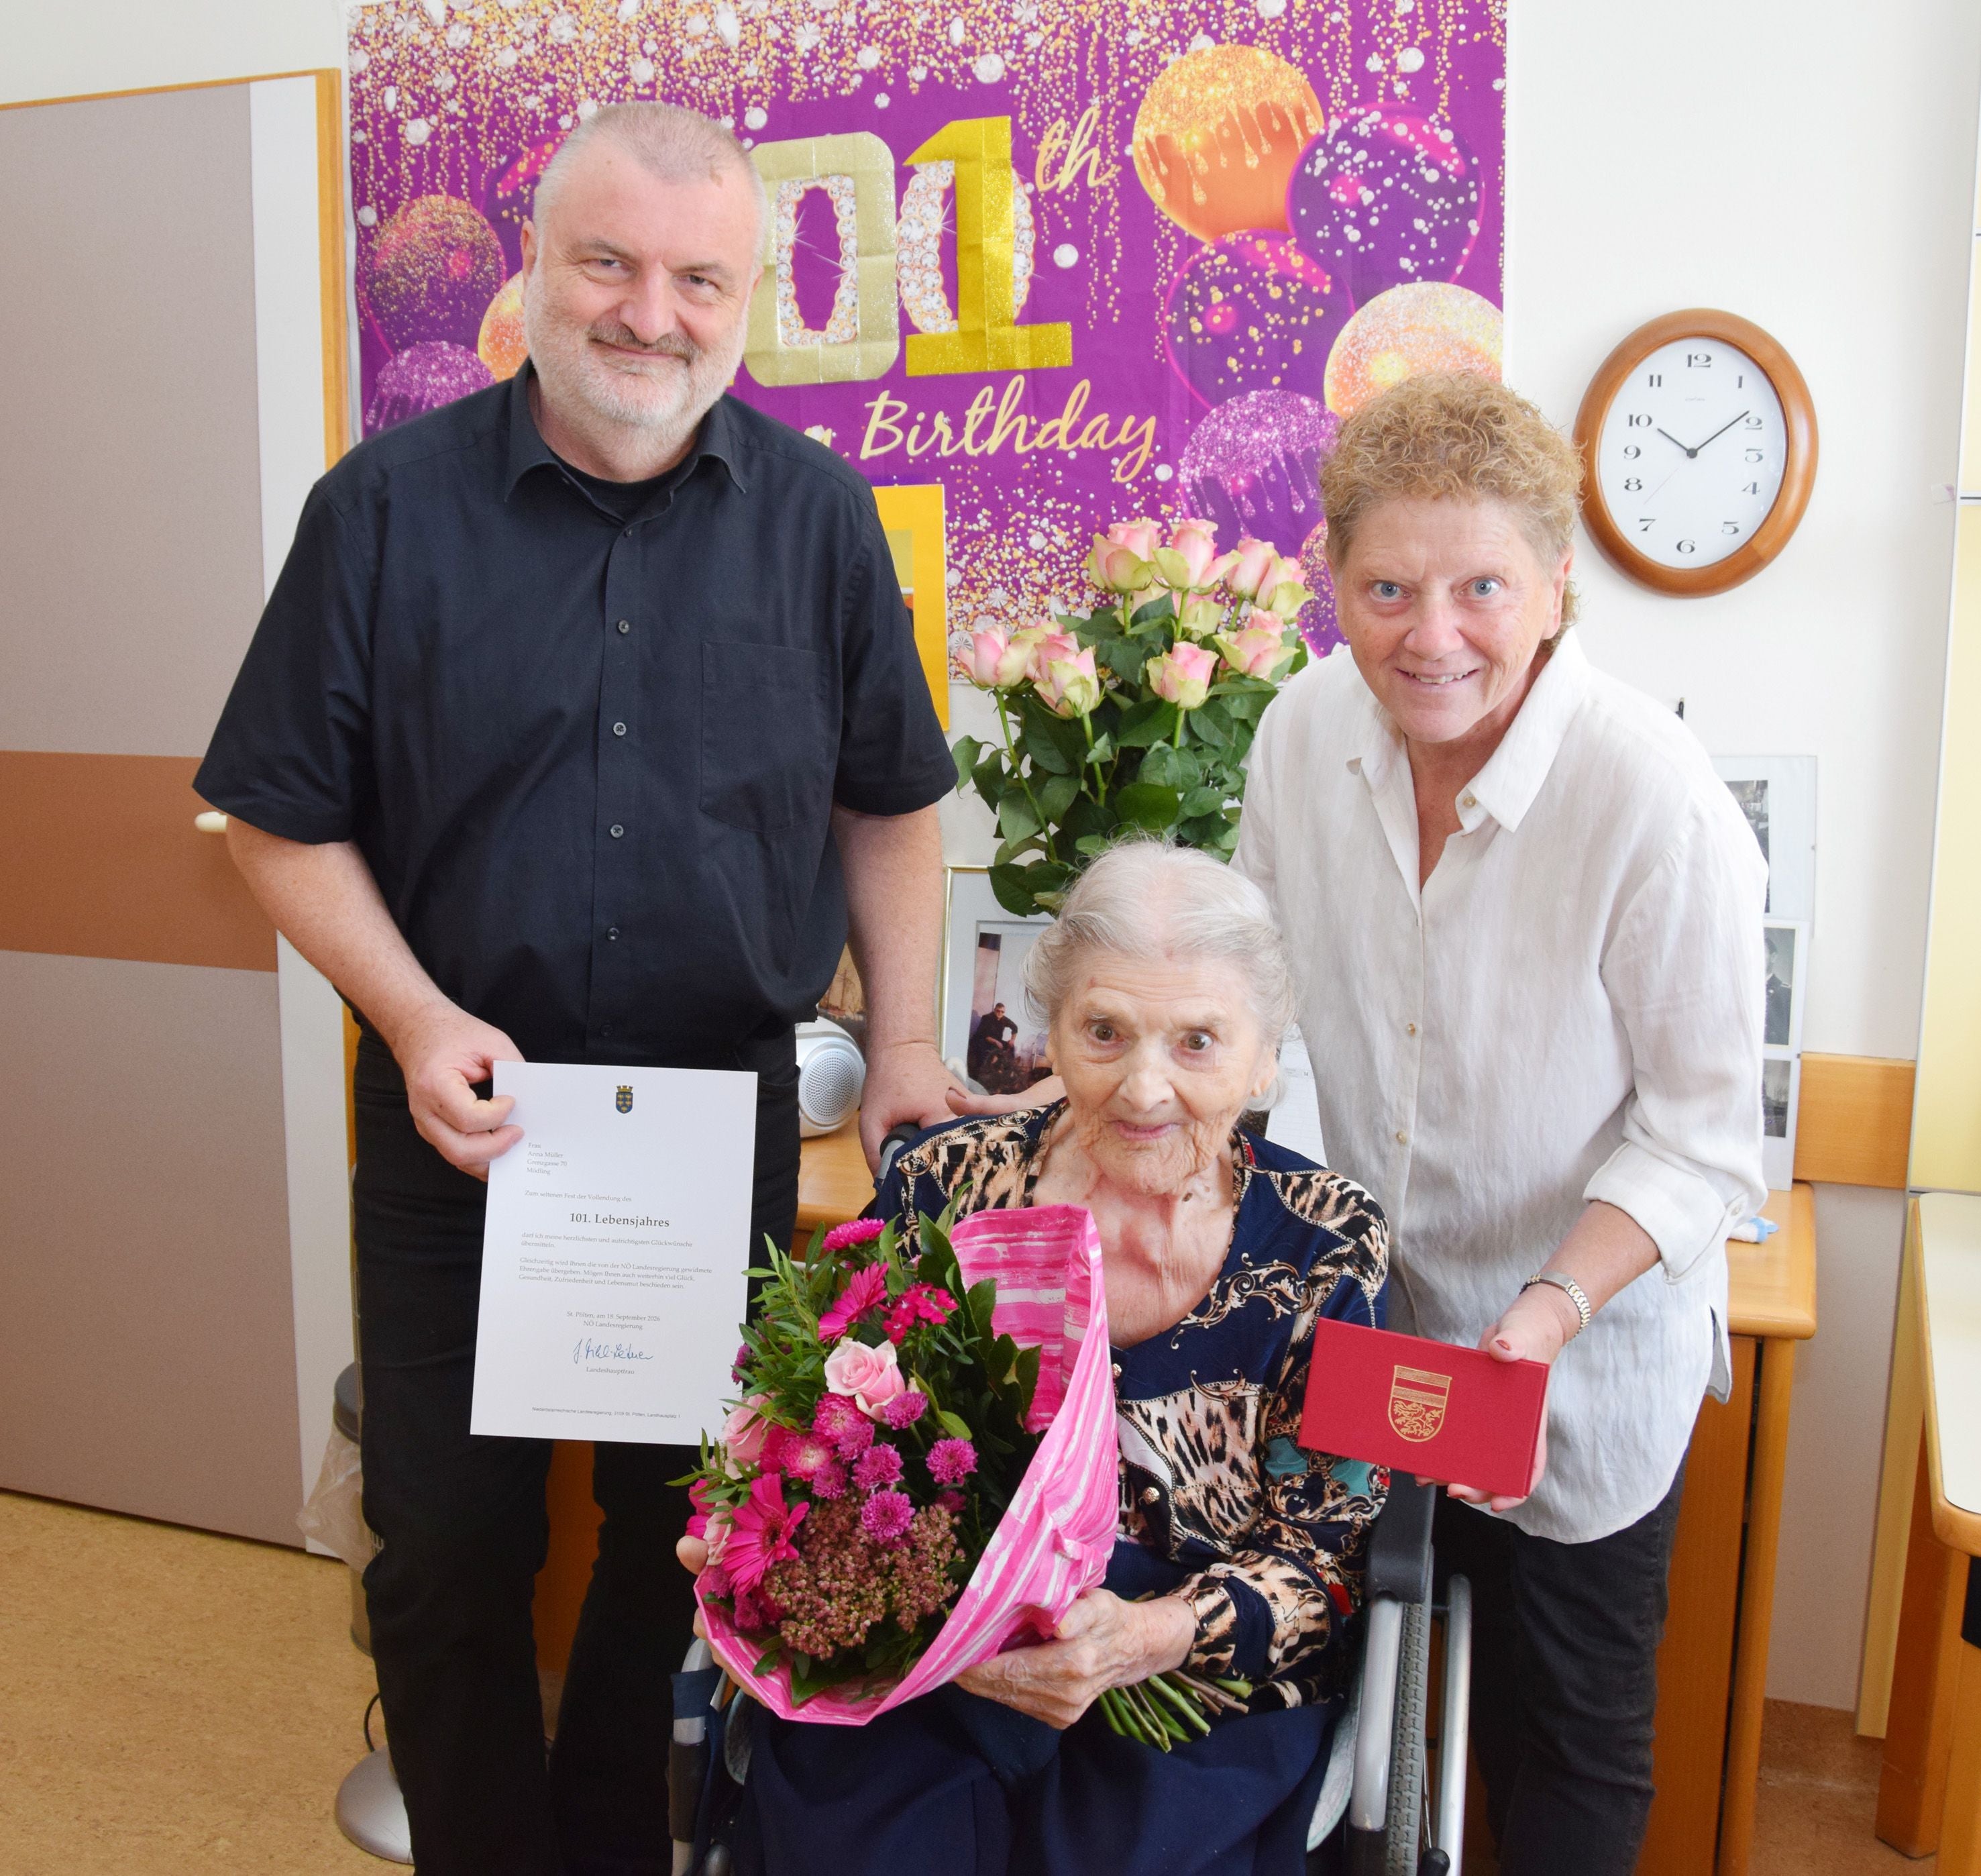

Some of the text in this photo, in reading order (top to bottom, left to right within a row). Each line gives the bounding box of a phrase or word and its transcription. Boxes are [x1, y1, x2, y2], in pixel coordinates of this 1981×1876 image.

[1686, 353, 1711, 368] 12
[1648, 374, 1662, 388] 11
[1737, 375, 1743, 388] 1
[1628, 413, 1653, 427] 10
[1745, 417, 1763, 430] 2
[859, 374, 1156, 483] Birthday
[1623, 445, 1641, 460] 9
[1745, 448, 1764, 463] 3
[1624, 478, 1643, 491] 8
[1742, 482, 1760, 495] 4
[1638, 519, 1656, 531] 7
[1721, 521, 1739, 535] 5
[1676, 539, 1695, 554] 6
[544, 1151, 564, 1159] Müller
[526, 1167, 551, 1176] Mödling
[588, 1194, 621, 1203] Vollendung
[570, 1212, 670, 1229] 101. Lebensjahres
[651, 1239, 693, 1247] Glückwünsche
[519, 1257, 554, 1266] Gleichzeitig
[633, 1264, 680, 1273] Landesregierung
[519, 1265, 550, 1273] Ehrengabe
[554, 1276, 594, 1284] Zufriedenheit
[616, 1314, 646, 1322] September
[595, 1320, 643, 1331] Landesregierung
[586, 1366, 635, 1375] Landeshauptfrau
